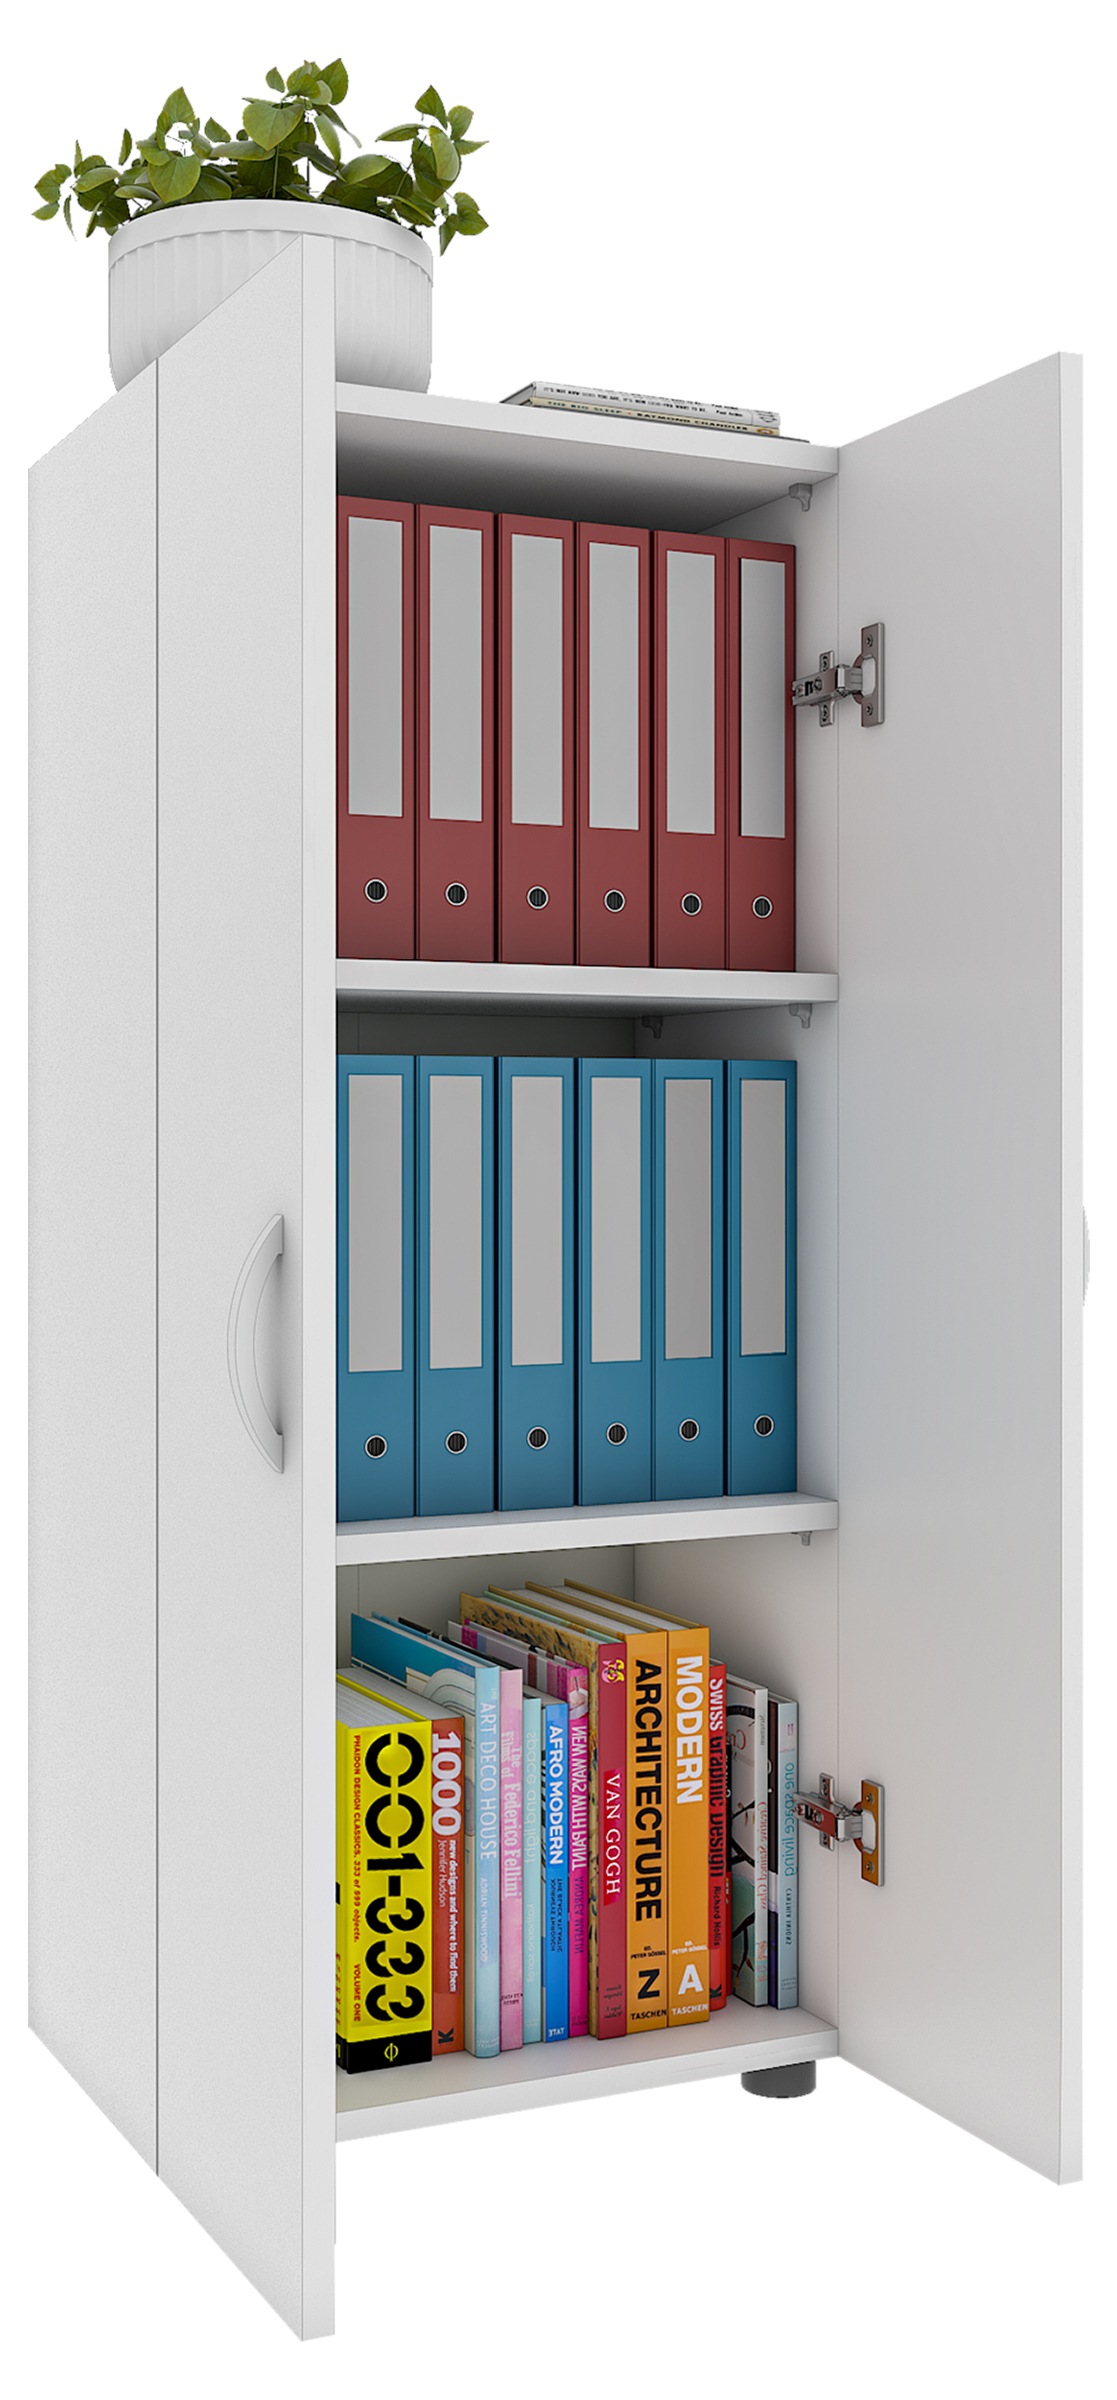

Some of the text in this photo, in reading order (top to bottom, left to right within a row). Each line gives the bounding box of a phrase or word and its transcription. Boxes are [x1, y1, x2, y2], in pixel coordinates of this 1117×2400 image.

[353, 1735, 361, 1774] PHAIDON
[501, 1731, 514, 1779] Films of
[511, 1746, 522, 1768] The
[676, 1655, 703, 1804] MODERN
[353, 1777, 361, 1809] DESIGN
[432, 1731, 462, 1836] 1000
[480, 1702, 497, 1860] ART DECO HOUSE
[549, 1725, 563, 1864] AFRO MODERN
[635, 1659, 662, 1921] ARCHITECTURE
[503, 1784, 522, 1898] Federico Fellini
[605, 1773, 621, 1895] VAN GOGH
[353, 1860, 361, 1876] 333
[365, 1731, 425, 2022] 001-333
[438, 1839, 448, 1907] Jennifer Hudson
[447, 1839, 458, 1992] new designs and where to find them
[480, 1877, 488, 1962] ADRIAN TINNISWOOD
[712, 1886, 722, 1947] Richard Hollis
[353, 1963, 361, 2022] VOLUME ONE
[637, 1968, 660, 1999] Z
[672, 2003, 709, 2016] TASCHEN
[678, 1963, 704, 1995] A
[631, 2009, 667, 2021] TASCHEN
